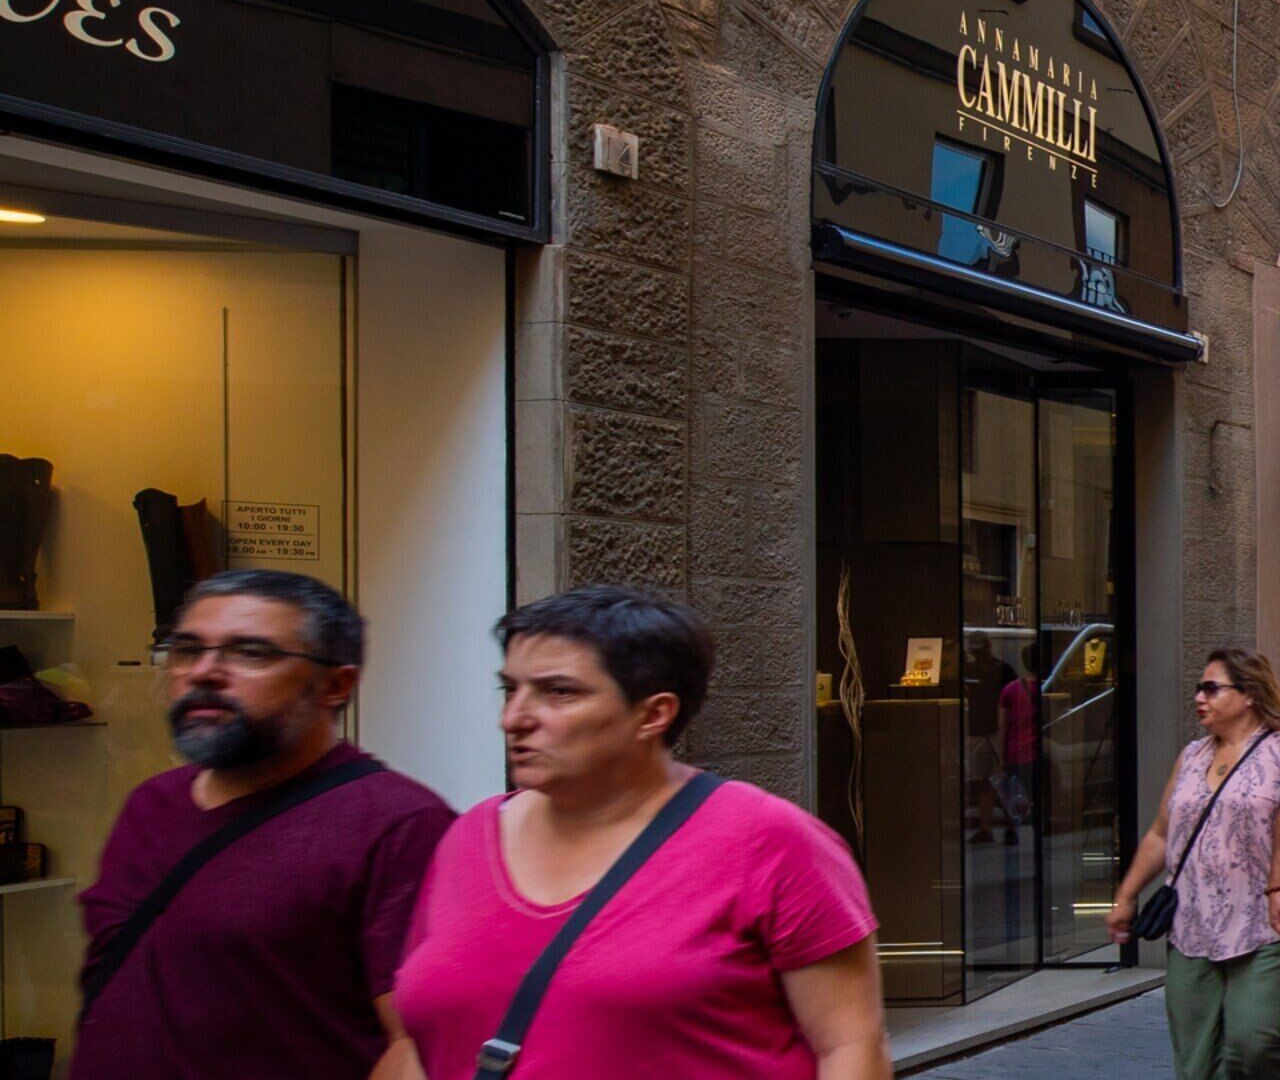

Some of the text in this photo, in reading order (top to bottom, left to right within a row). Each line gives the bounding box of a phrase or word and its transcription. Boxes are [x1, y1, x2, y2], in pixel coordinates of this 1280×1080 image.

[958, 10, 1097, 101] ANNAMARIA
[957, 43, 1097, 163] CAMMILLI
[958, 117, 1097, 189] FIRENZE
[236, 506, 306, 516] APERTO TUTTI
[256, 514, 291, 523] GIORNI
[238, 523, 266, 531] 10:00
[276, 524, 304, 533] 19:30
[228, 537, 257, 545] OPEN
[293, 540, 313, 548] DAY
[276, 548, 304, 556] 19:30
